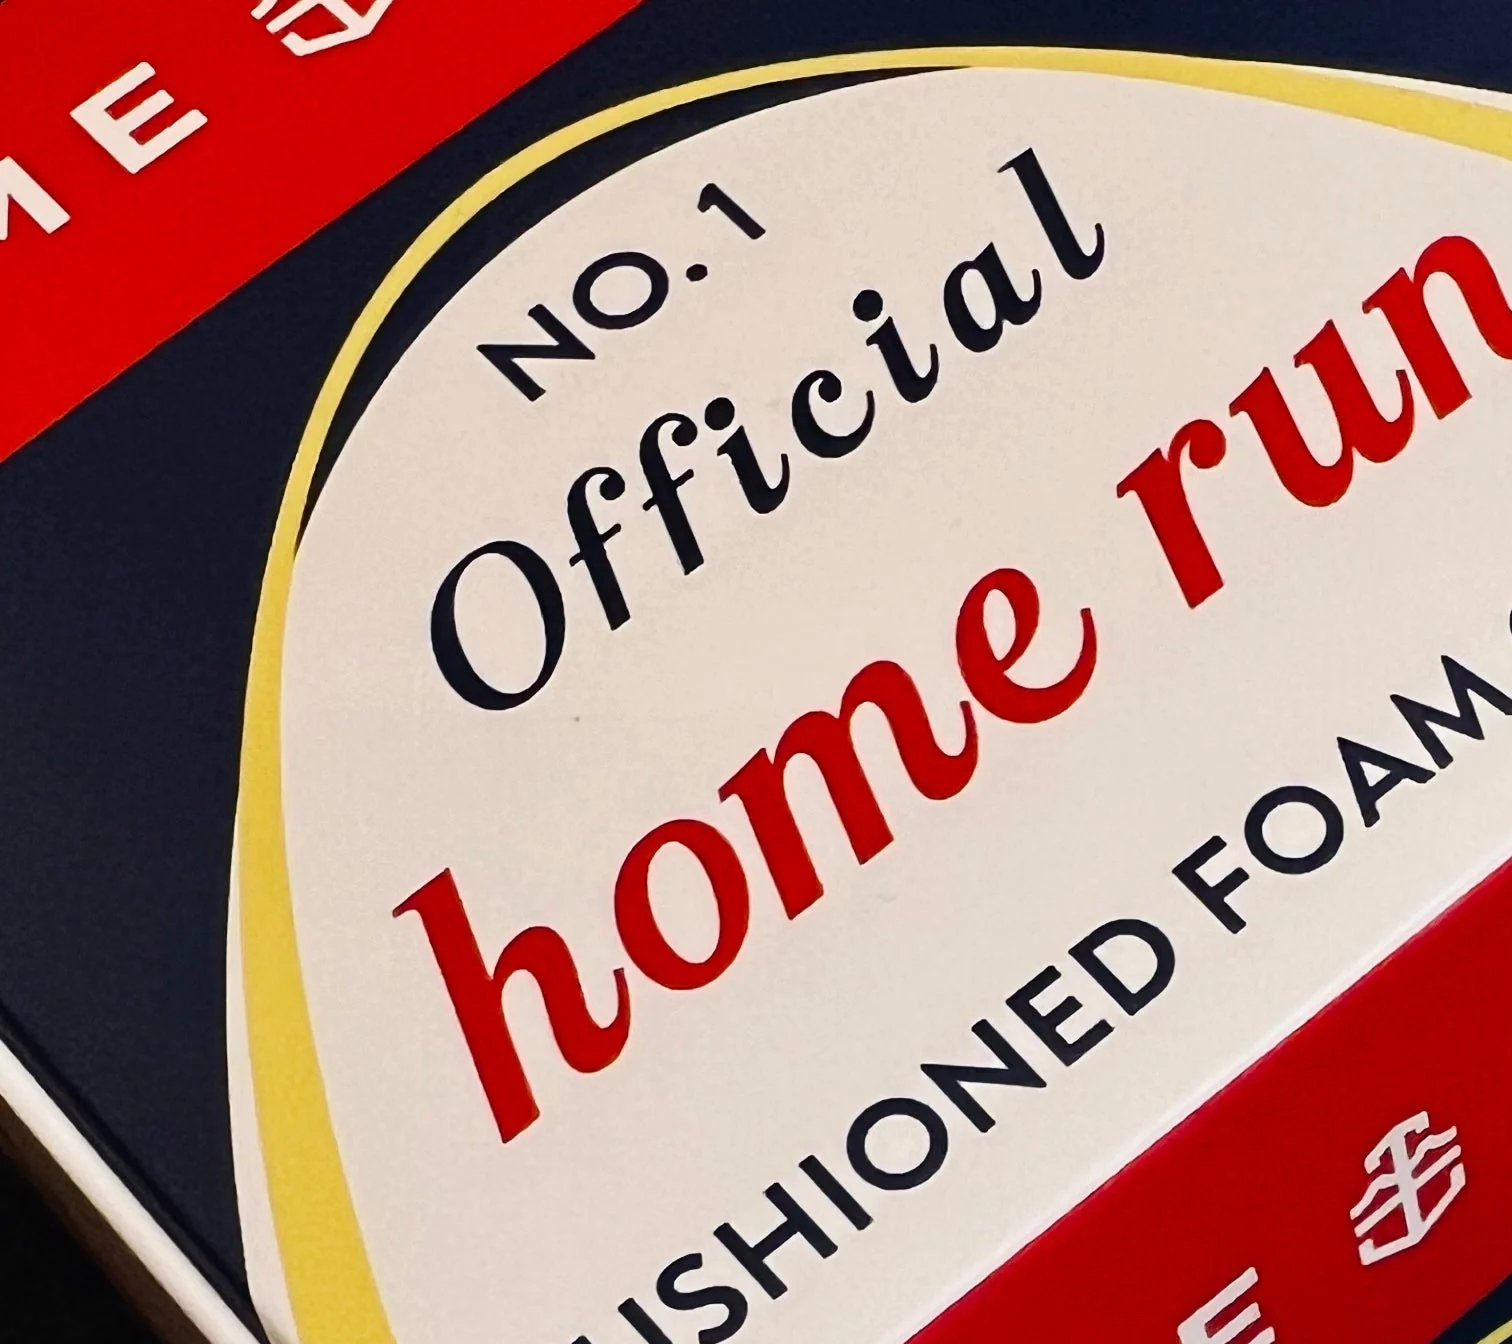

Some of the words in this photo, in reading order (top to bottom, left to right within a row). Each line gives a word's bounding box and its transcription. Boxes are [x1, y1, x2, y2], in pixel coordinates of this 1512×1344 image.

[430, 149, 1106, 712] Official
[477, 182, 767, 402] NO.1
[392, 567, 1099, 1144] home
